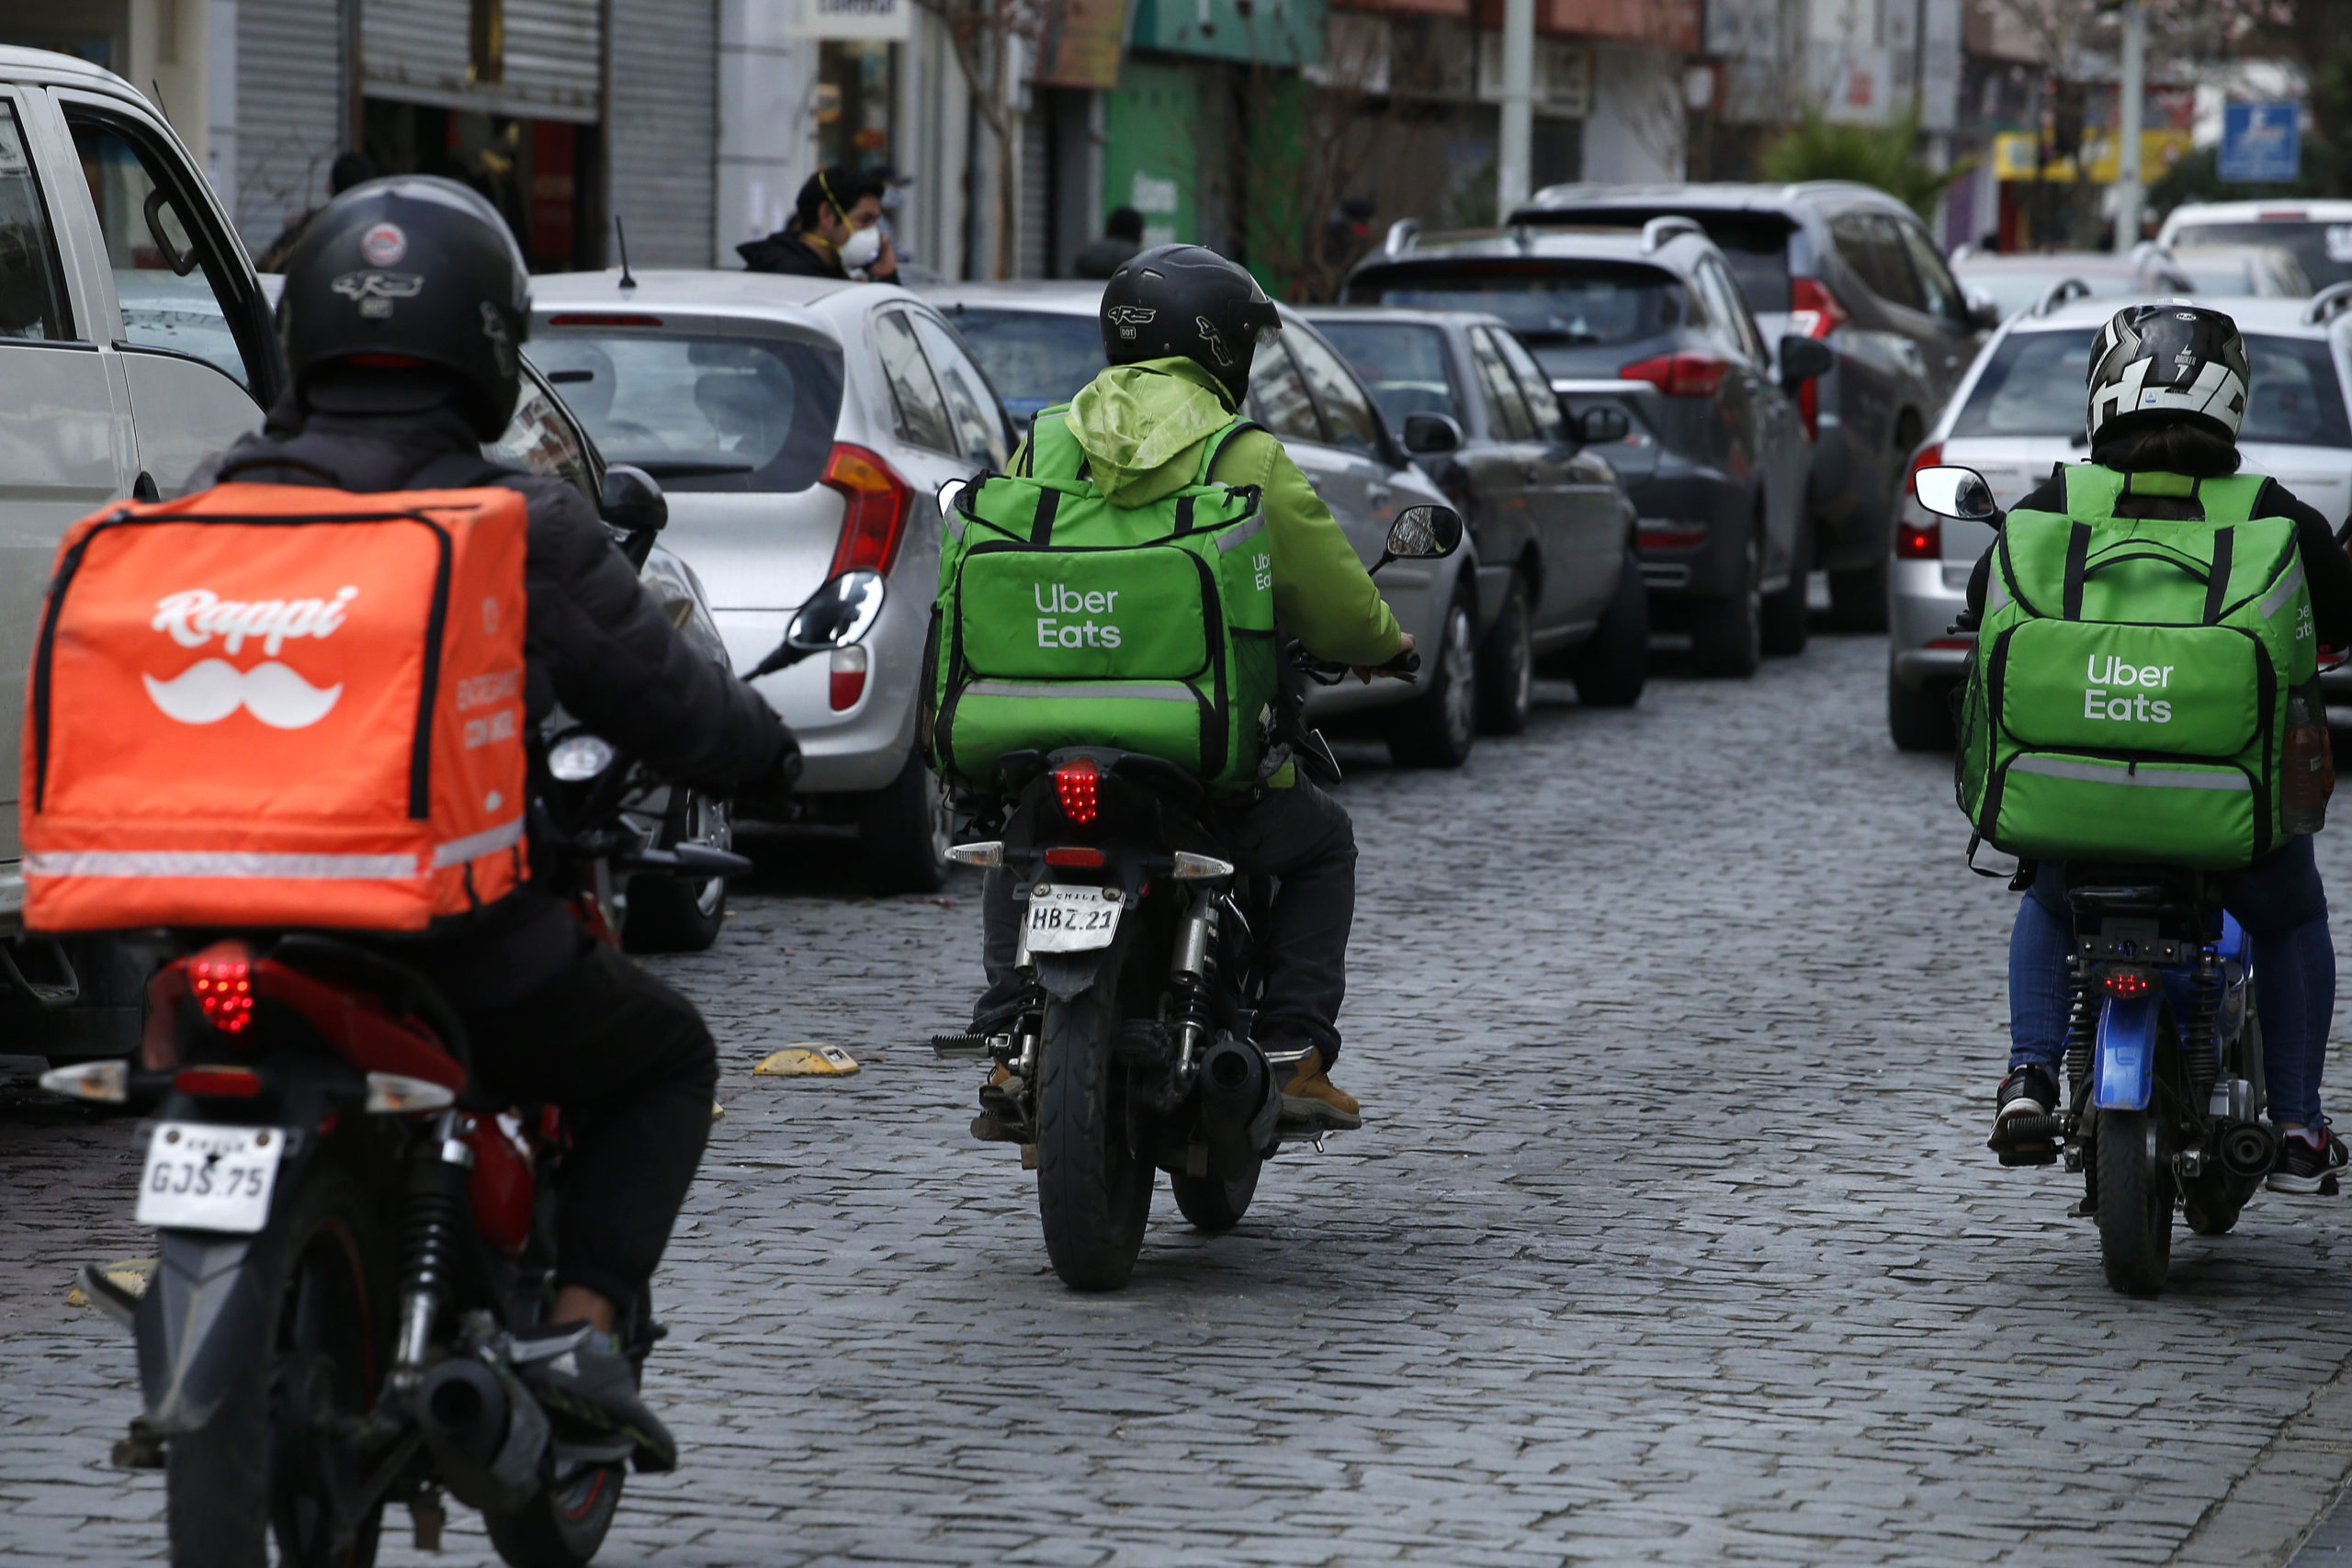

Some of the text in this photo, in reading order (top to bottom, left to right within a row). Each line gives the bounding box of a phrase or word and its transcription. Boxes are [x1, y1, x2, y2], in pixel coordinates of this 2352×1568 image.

[1121, 327, 1135, 338] DOT
[1035, 582, 1118, 614] Uber
[151, 585, 359, 657] Rappi
[1037, 617, 1121, 649] Eats
[2087, 654, 2174, 688] Uber
[2084, 689, 2172, 724] Eats
[1056, 893, 1100, 902] CHILE
